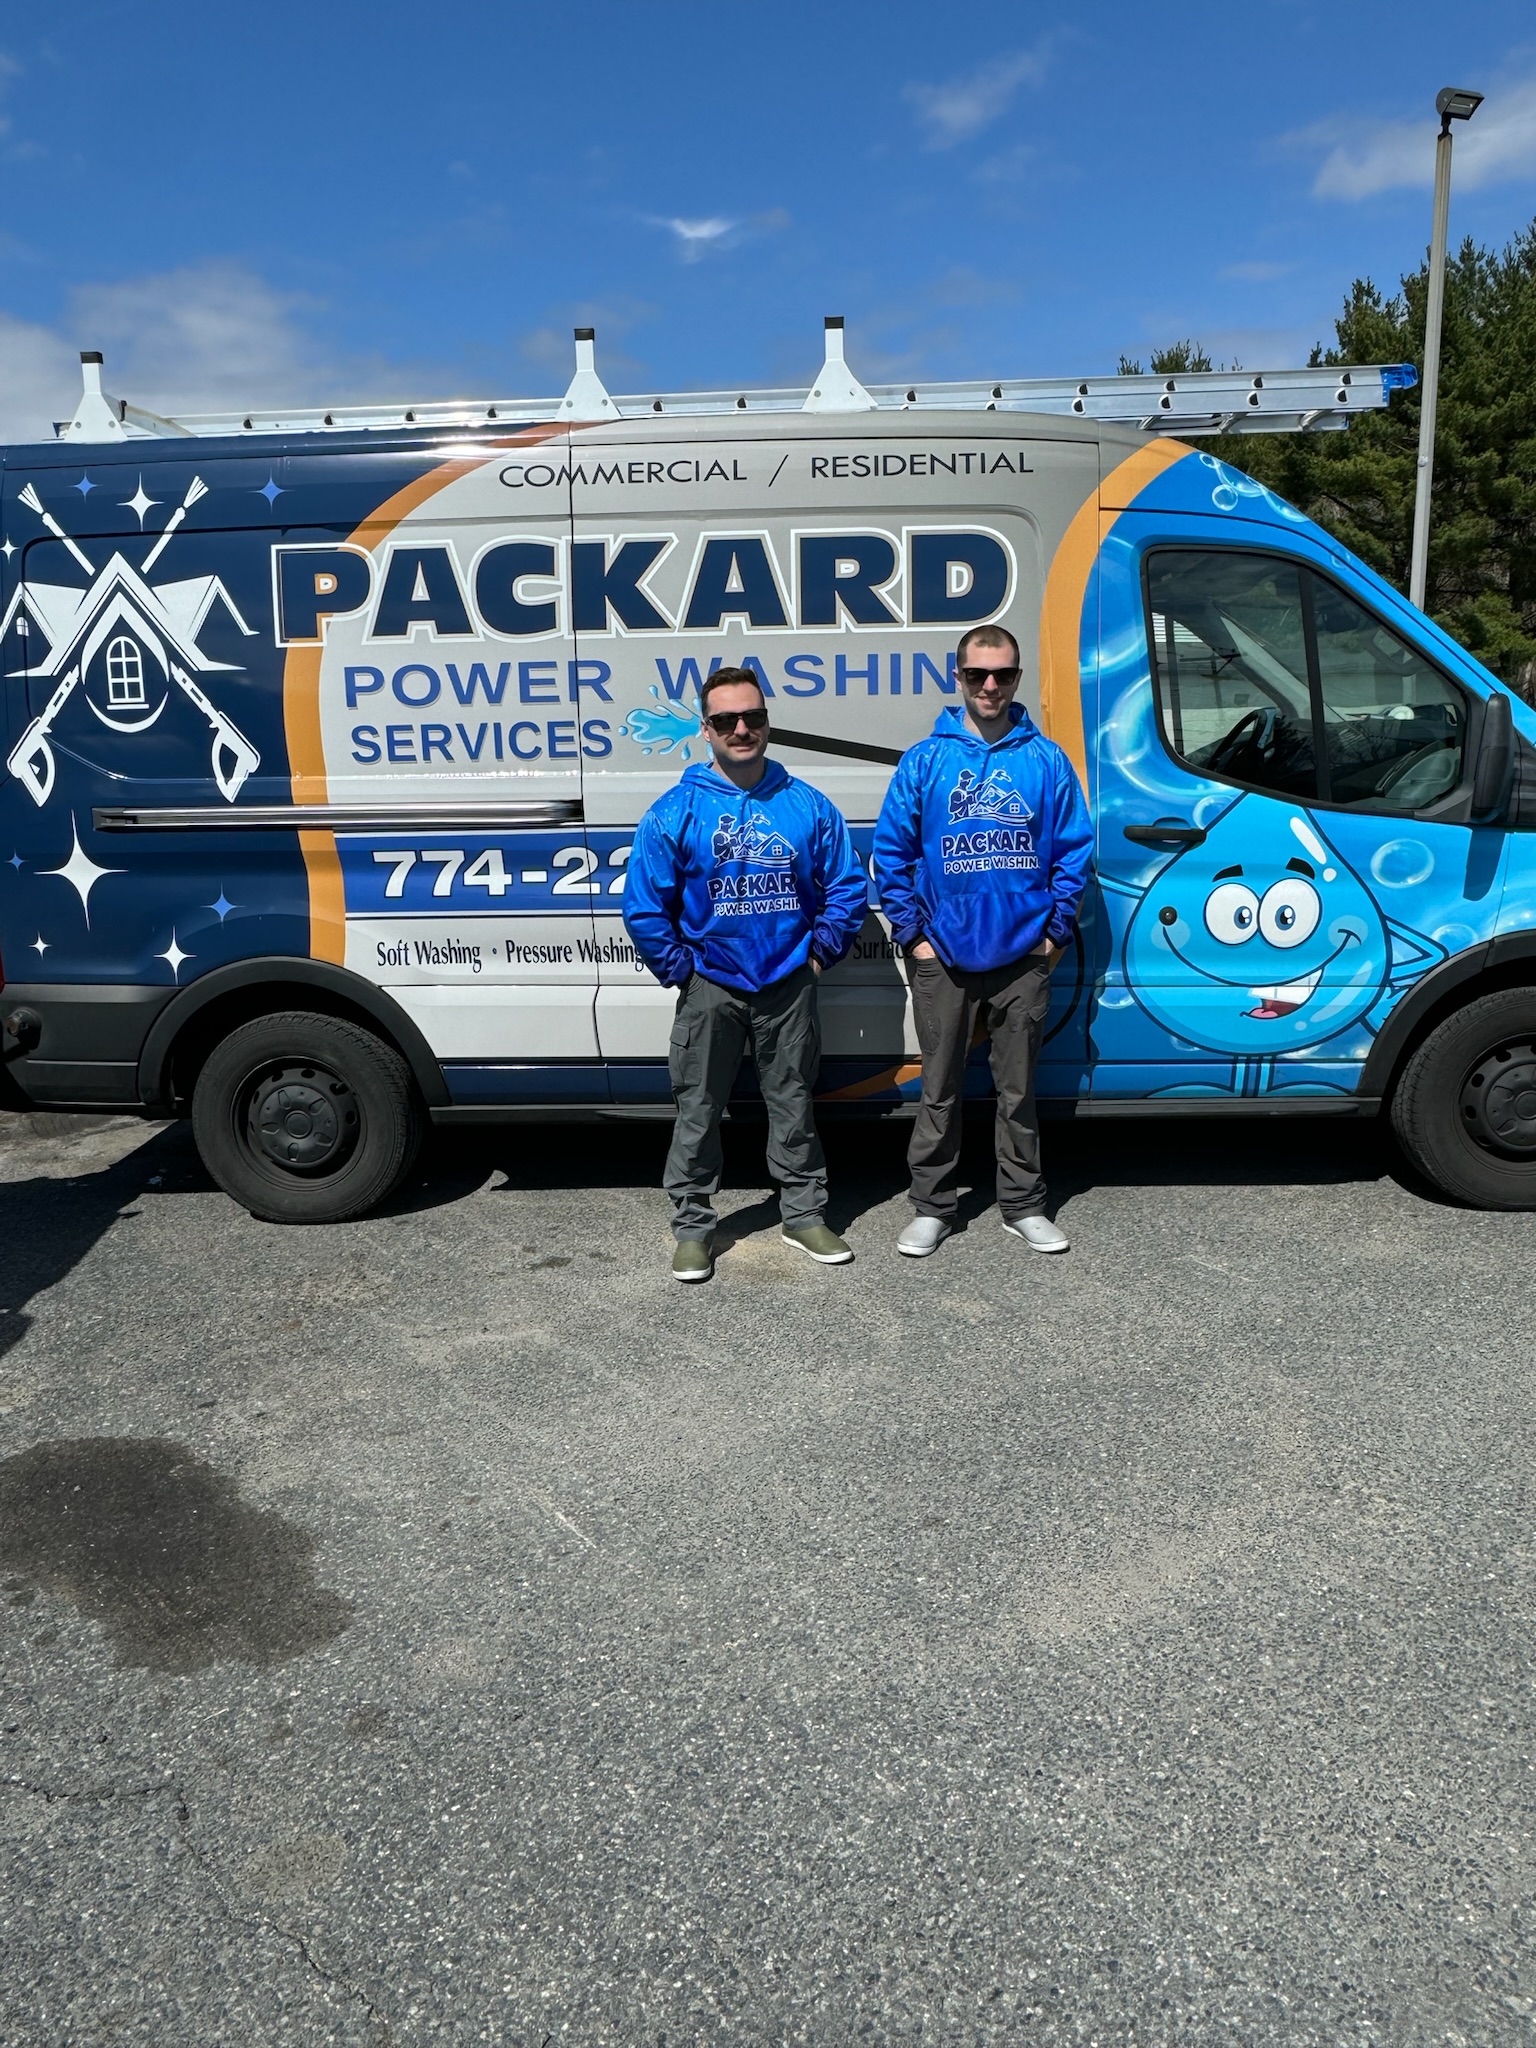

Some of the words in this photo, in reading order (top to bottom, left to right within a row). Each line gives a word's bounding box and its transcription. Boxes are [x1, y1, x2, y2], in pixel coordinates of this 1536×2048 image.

[498, 458, 748, 489] COMMERCIAL
[811, 451, 1035, 479] RESIDENTIAL
[271, 524, 1018, 648] PACKARD
[344, 659, 615, 710] POWER
[654, 652, 957, 698] WASHIN
[351, 719, 614, 765] SERVICES
[940, 829, 1035, 858] PACKAR
[944, 857, 992, 875] POWER
[706, 871, 798, 900] PACKAR
[713, 901, 753, 917] POWER
[753, 896, 801, 914] WASHI
[377, 939, 411, 966] Soft
[414, 937, 483, 974] Washing
[505, 938, 573, 964] Pressure
